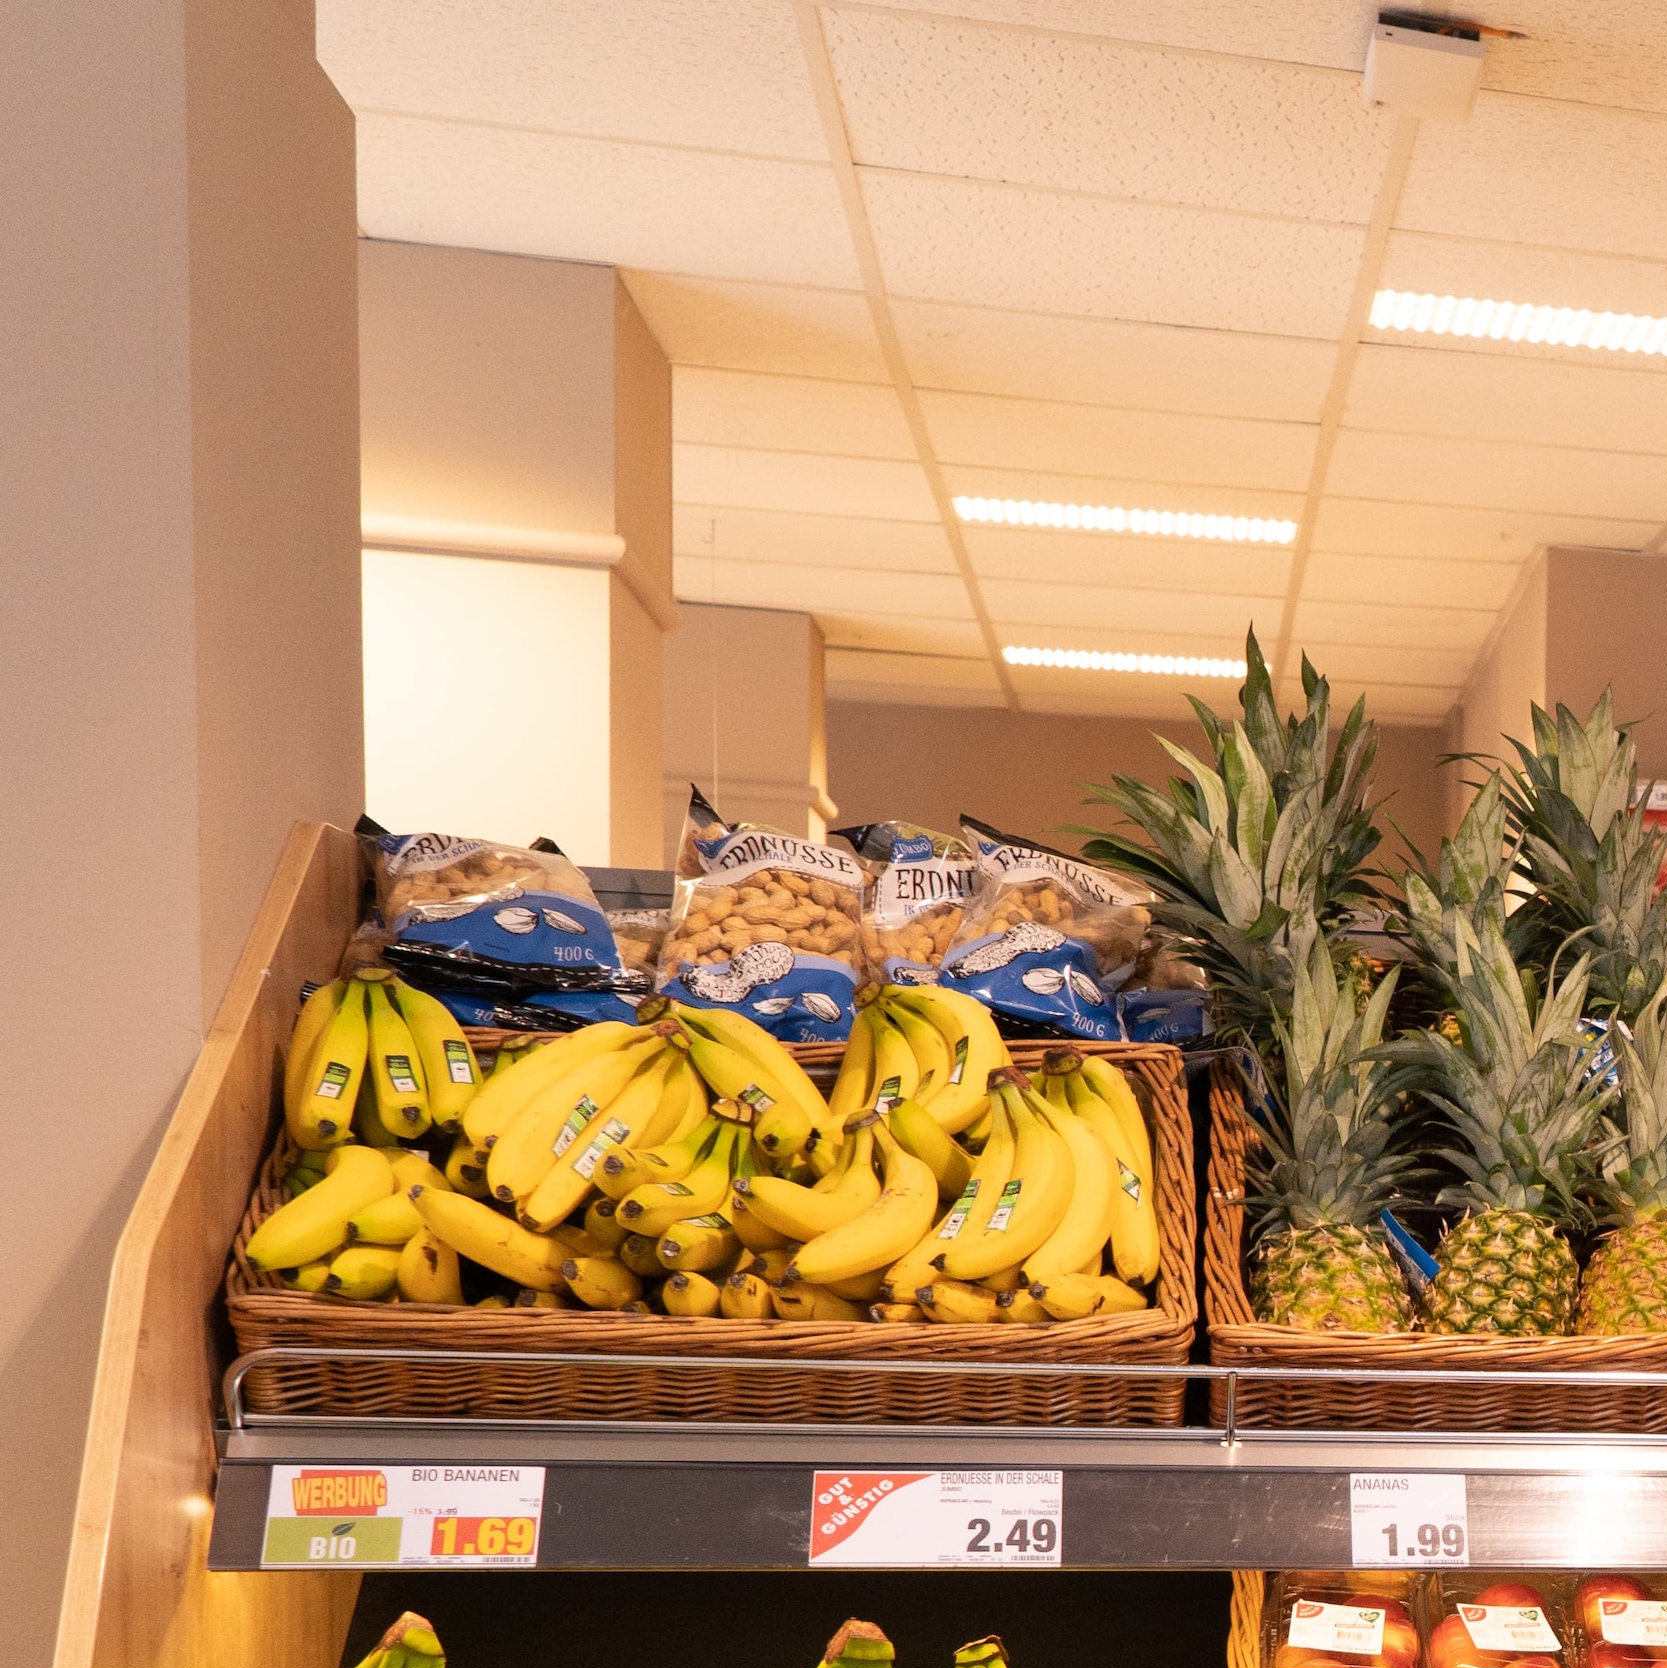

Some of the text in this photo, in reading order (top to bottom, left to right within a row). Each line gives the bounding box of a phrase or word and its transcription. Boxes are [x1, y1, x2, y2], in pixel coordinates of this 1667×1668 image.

[552, 945, 582, 962] 400
[1071, 1011, 1095, 1034] 400
[412, 1469, 520, 1482] BIO BANANEN
[940, 1473, 1060, 1485] ERDNUESSE IN DER SCHALE
[1353, 1479, 1410, 1490] ANANAS
[292, 1472, 388, 1512] WERBUNG
[818, 1477, 854, 1505] GUT
[840, 1492, 854, 1506] &
[821, 1479, 895, 1535] GÜNSTIG
[437, 1517, 536, 1555] 1.69
[966, 1518, 1057, 1552] 2.49
[1382, 1523, 1465, 1557] 1.99
[309, 1536, 357, 1559] BIO
